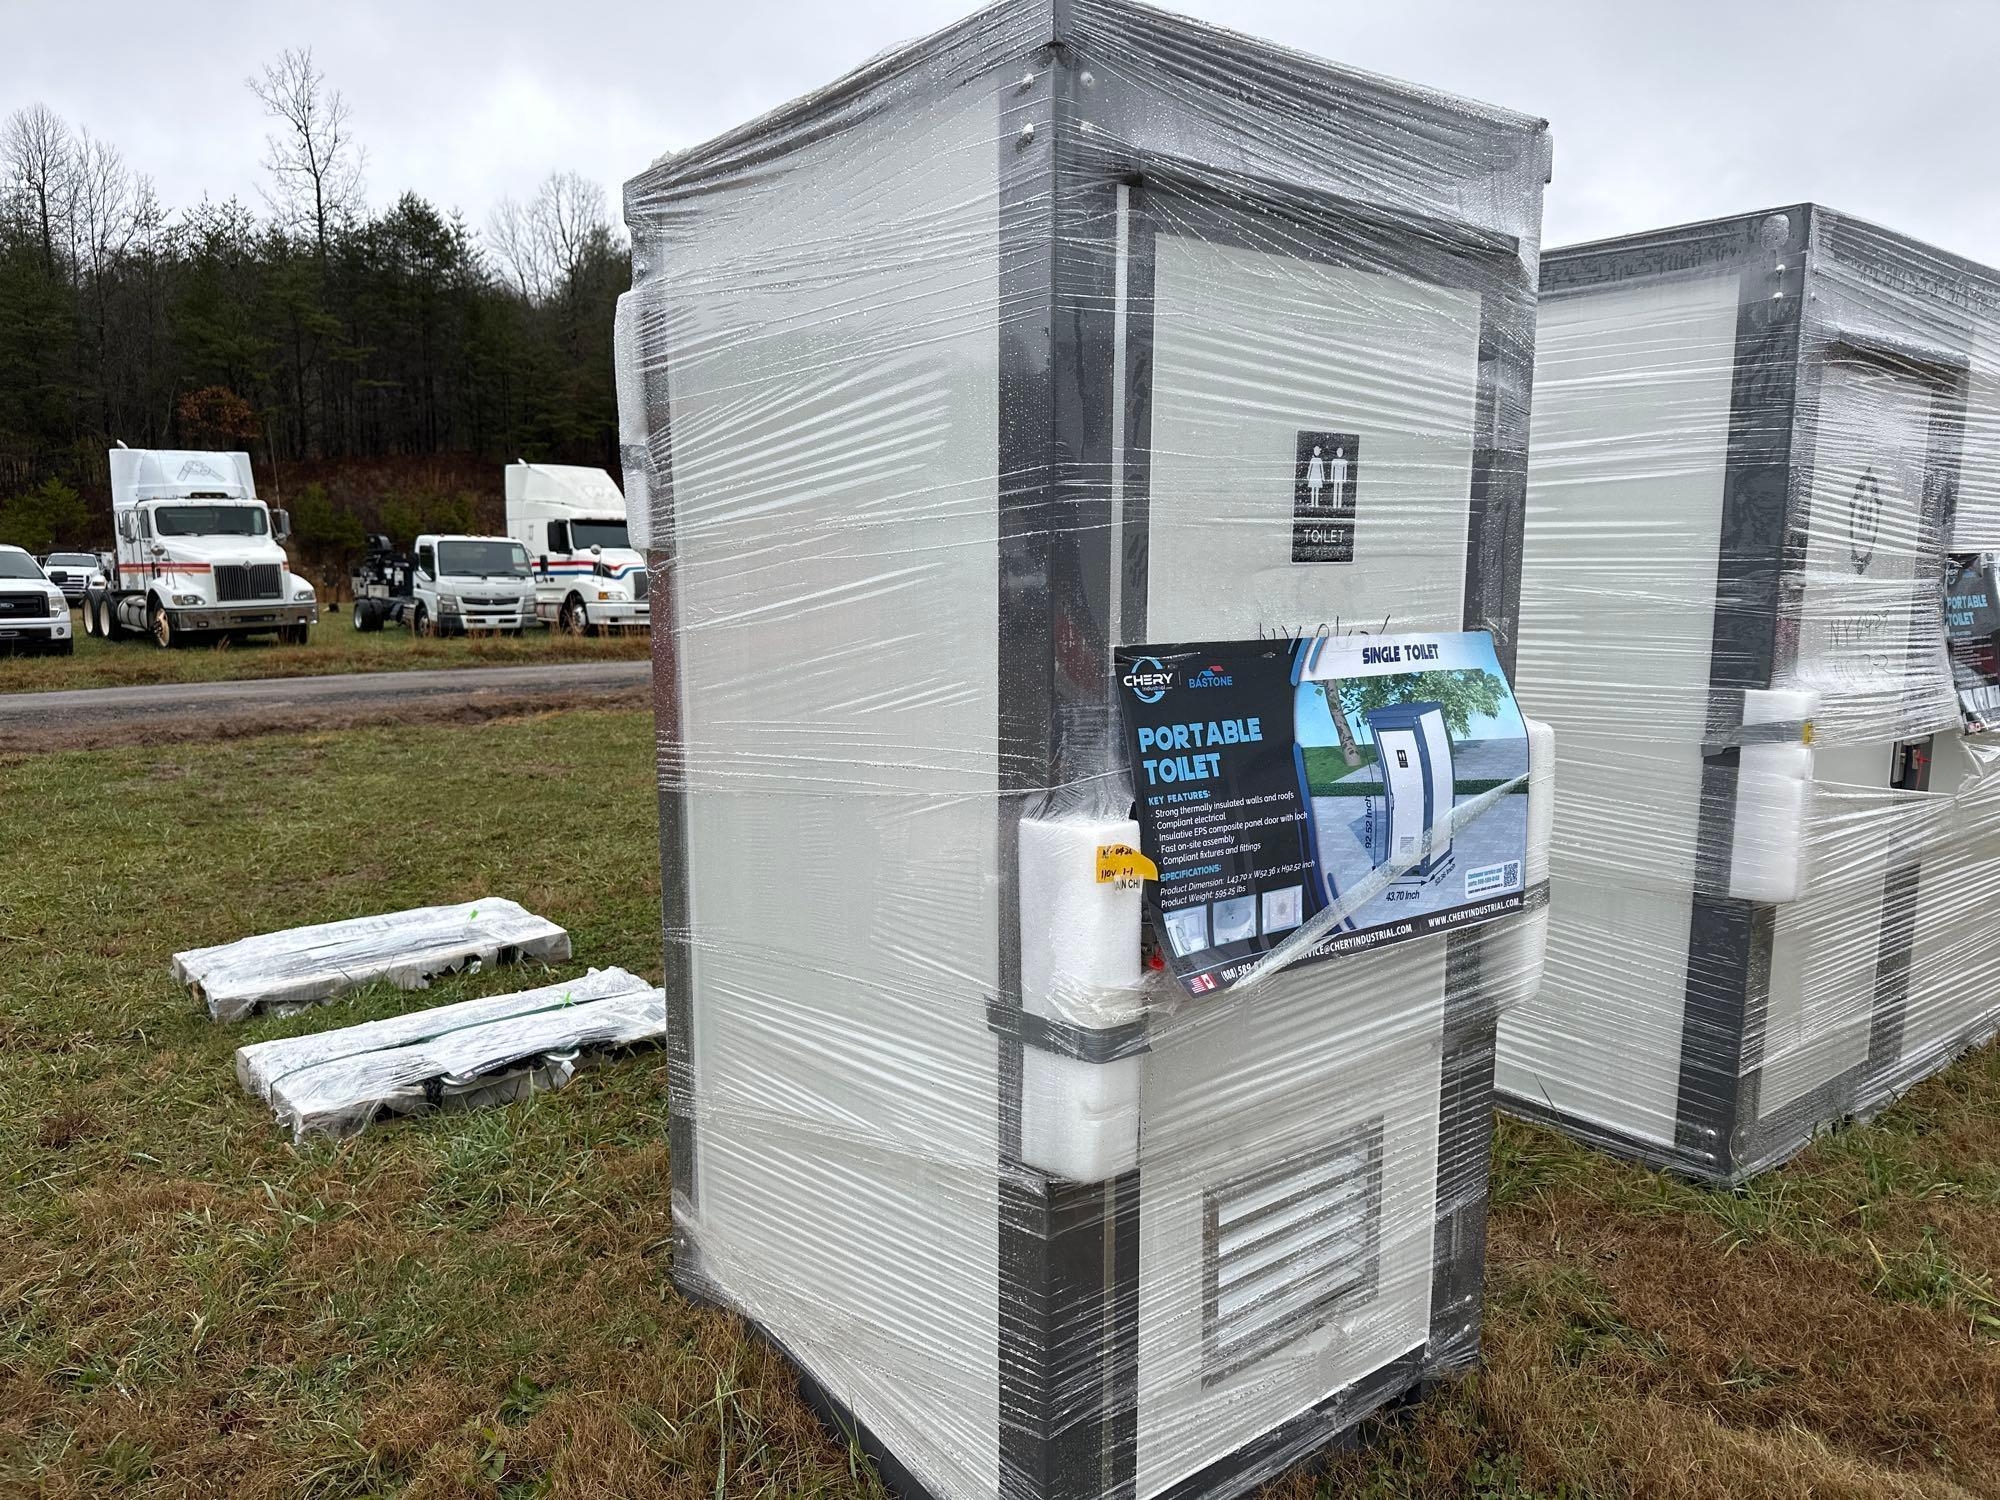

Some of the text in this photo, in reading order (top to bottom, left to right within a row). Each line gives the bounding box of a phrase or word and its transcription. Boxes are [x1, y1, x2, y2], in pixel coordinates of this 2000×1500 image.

[1303, 529, 1345, 543] TOILET
[1947, 595, 1988, 609] PORTABLE
[1948, 611, 1974, 626] TOILET
[1362, 643, 1440, 664] SINGLE TOILET
[1123, 671, 1173, 687] CHERY
[1189, 676, 1233, 688] BASTONE
[1138, 717, 1264, 753] PORTABLE
[1143, 752, 1221, 785] TOILET
[1148, 790, 1212, 806] KEY FEATURES:
[1155, 790, 1295, 819] Strong thermally insulated walls and roofs
[1157, 812, 1226, 831] Compliant electrical
[1159, 810, 1308, 842] Insulative EPS composite panel door with lock
[1364, 794, 1373, 849] 92.52 Inch
[1161, 833, 1235, 854] Fast on-site assembly
[1162, 841, 1261, 866] Compliant fixtures and fittings
[1160, 864, 1222, 882] SPECIFICATIONS:
[1160, 884, 1187, 897] Product
[1188, 877, 1224, 891] Dimension:
[1253, 866, 1276, 879] W52.36
[1161, 896, 1187, 909] Product
[1188, 890, 1214, 905] Weight:
[1214, 887, 1236, 899] 595.25
[1386, 889, 1420, 902] 43.70 Inch
[1428, 897, 1519, 928] WWW.CHERYINDUSTRIAL.COM
